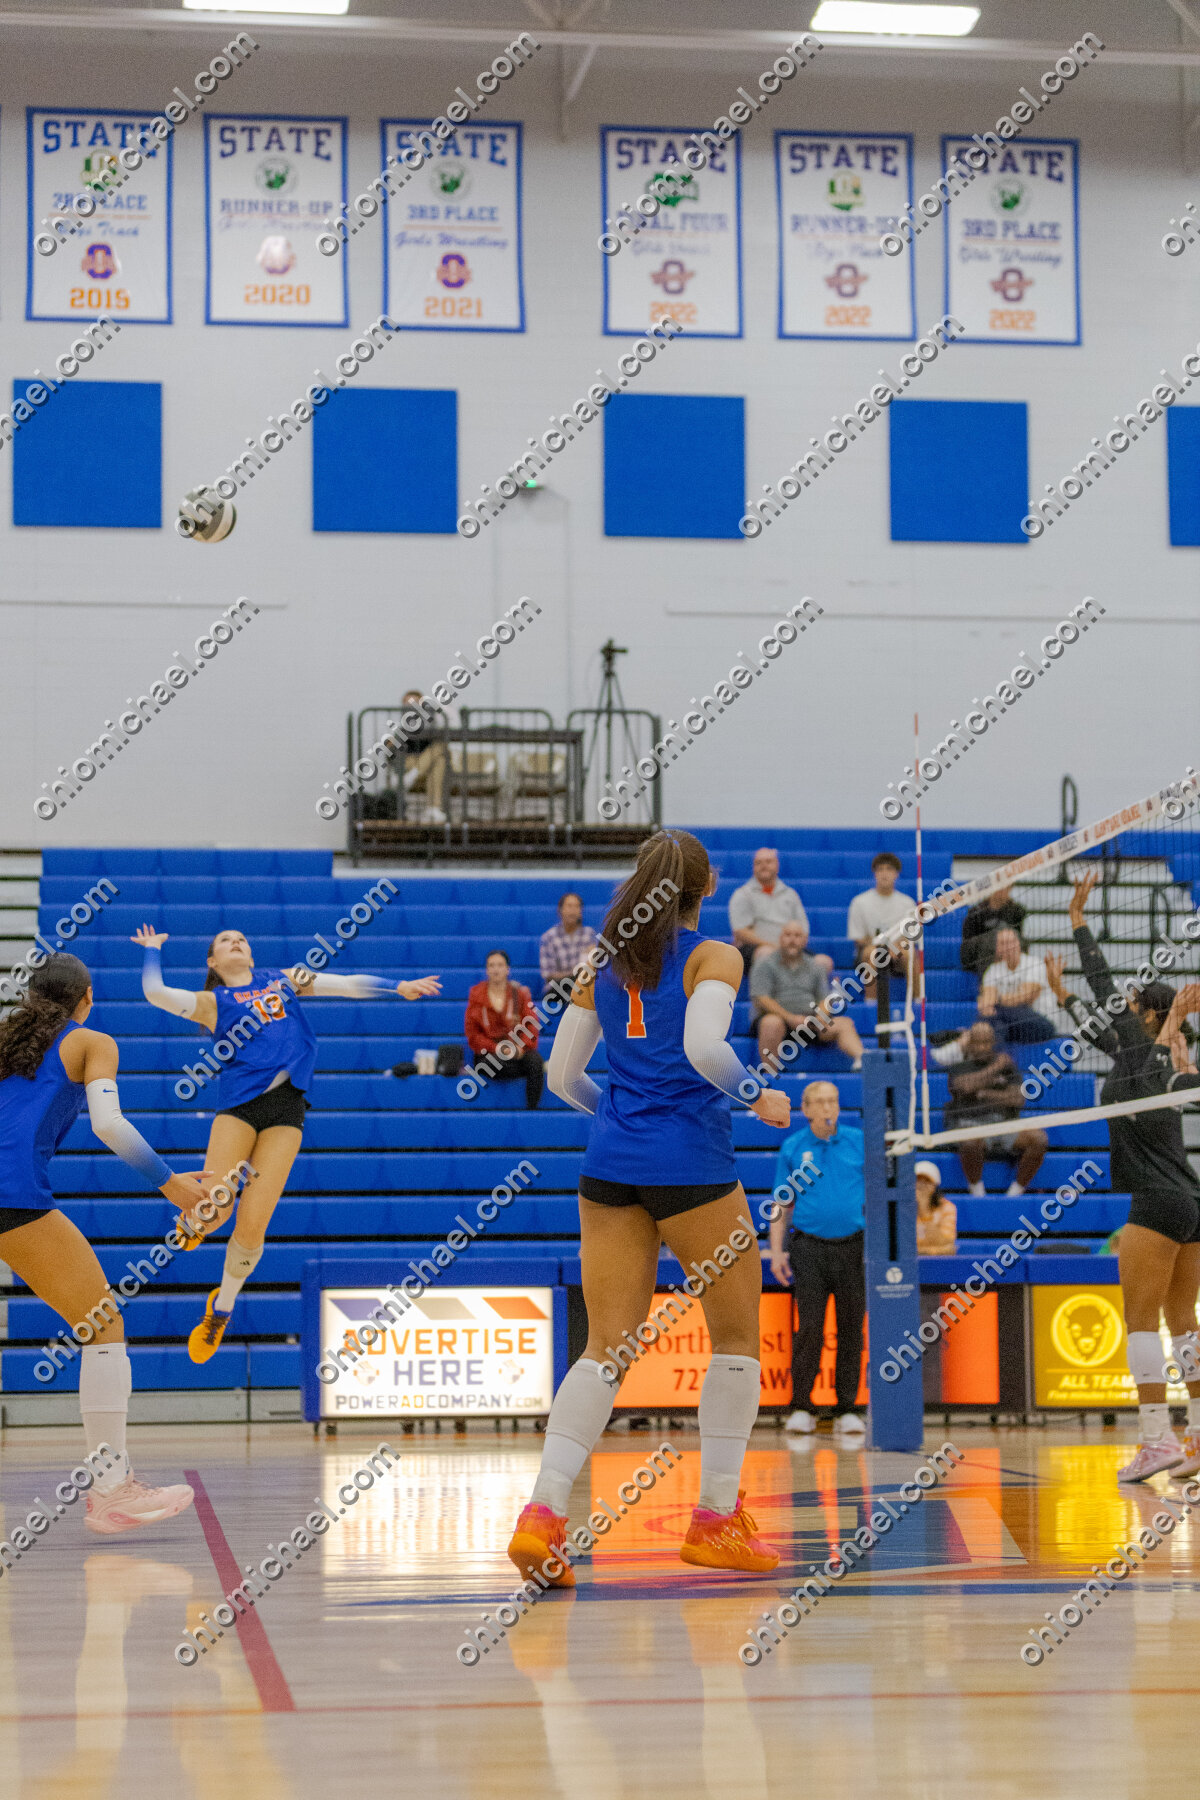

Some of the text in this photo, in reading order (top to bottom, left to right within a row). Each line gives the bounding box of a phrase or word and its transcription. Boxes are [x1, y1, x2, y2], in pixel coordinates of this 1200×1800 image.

[219, 125, 332, 161] STATE
[789, 142, 899, 178] STATE
[220, 199, 334, 215] RUNNER-UP
[444, 206, 499, 222] PLACE
[244, 284, 311, 306] 2020
[423, 297, 483, 319] 2021
[623, 981, 647, 1039] 1
[340, 1328, 537, 1356] ADVERTISE
[393, 1359, 484, 1386] HERE
[1058, 1374, 1089, 1389] ALL
[335, 1394, 544, 1410] POWERADCOMPANY.COM
